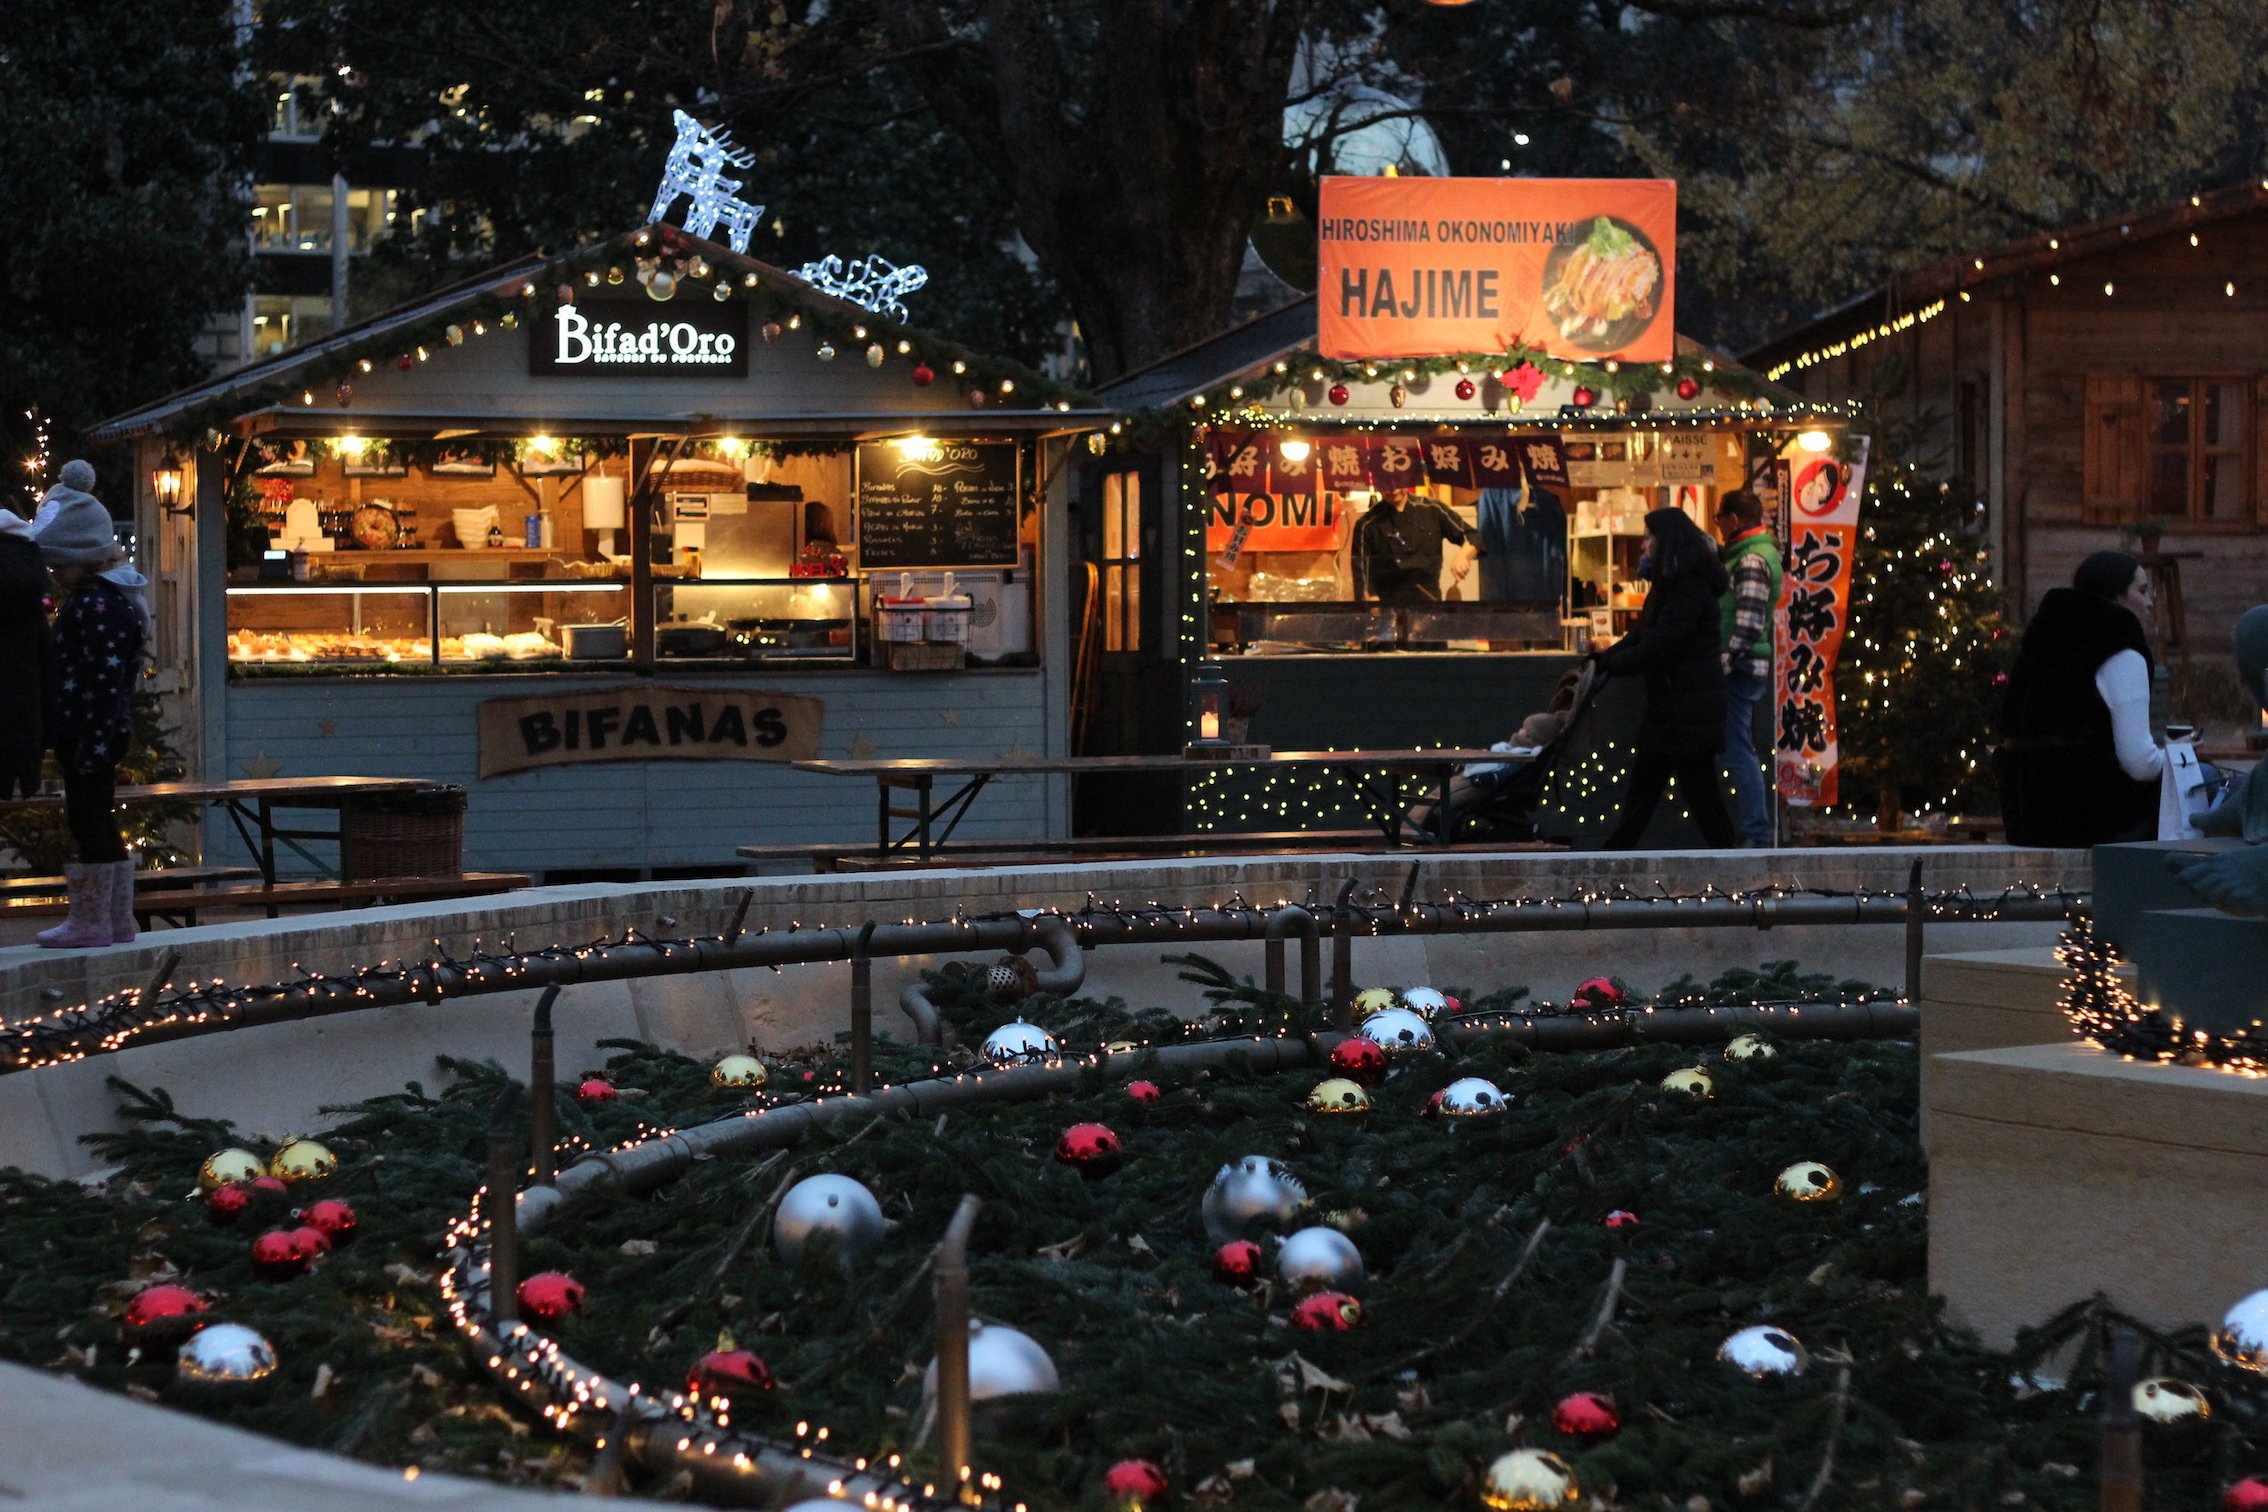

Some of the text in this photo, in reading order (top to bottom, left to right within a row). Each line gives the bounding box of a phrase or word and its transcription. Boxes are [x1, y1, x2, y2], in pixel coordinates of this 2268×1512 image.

[1321, 218, 1576, 247] HIROSHIMA OKONOMIYAKI
[1340, 267, 1500, 319] HAJIME
[518, 702, 788, 755] BIFANAS
